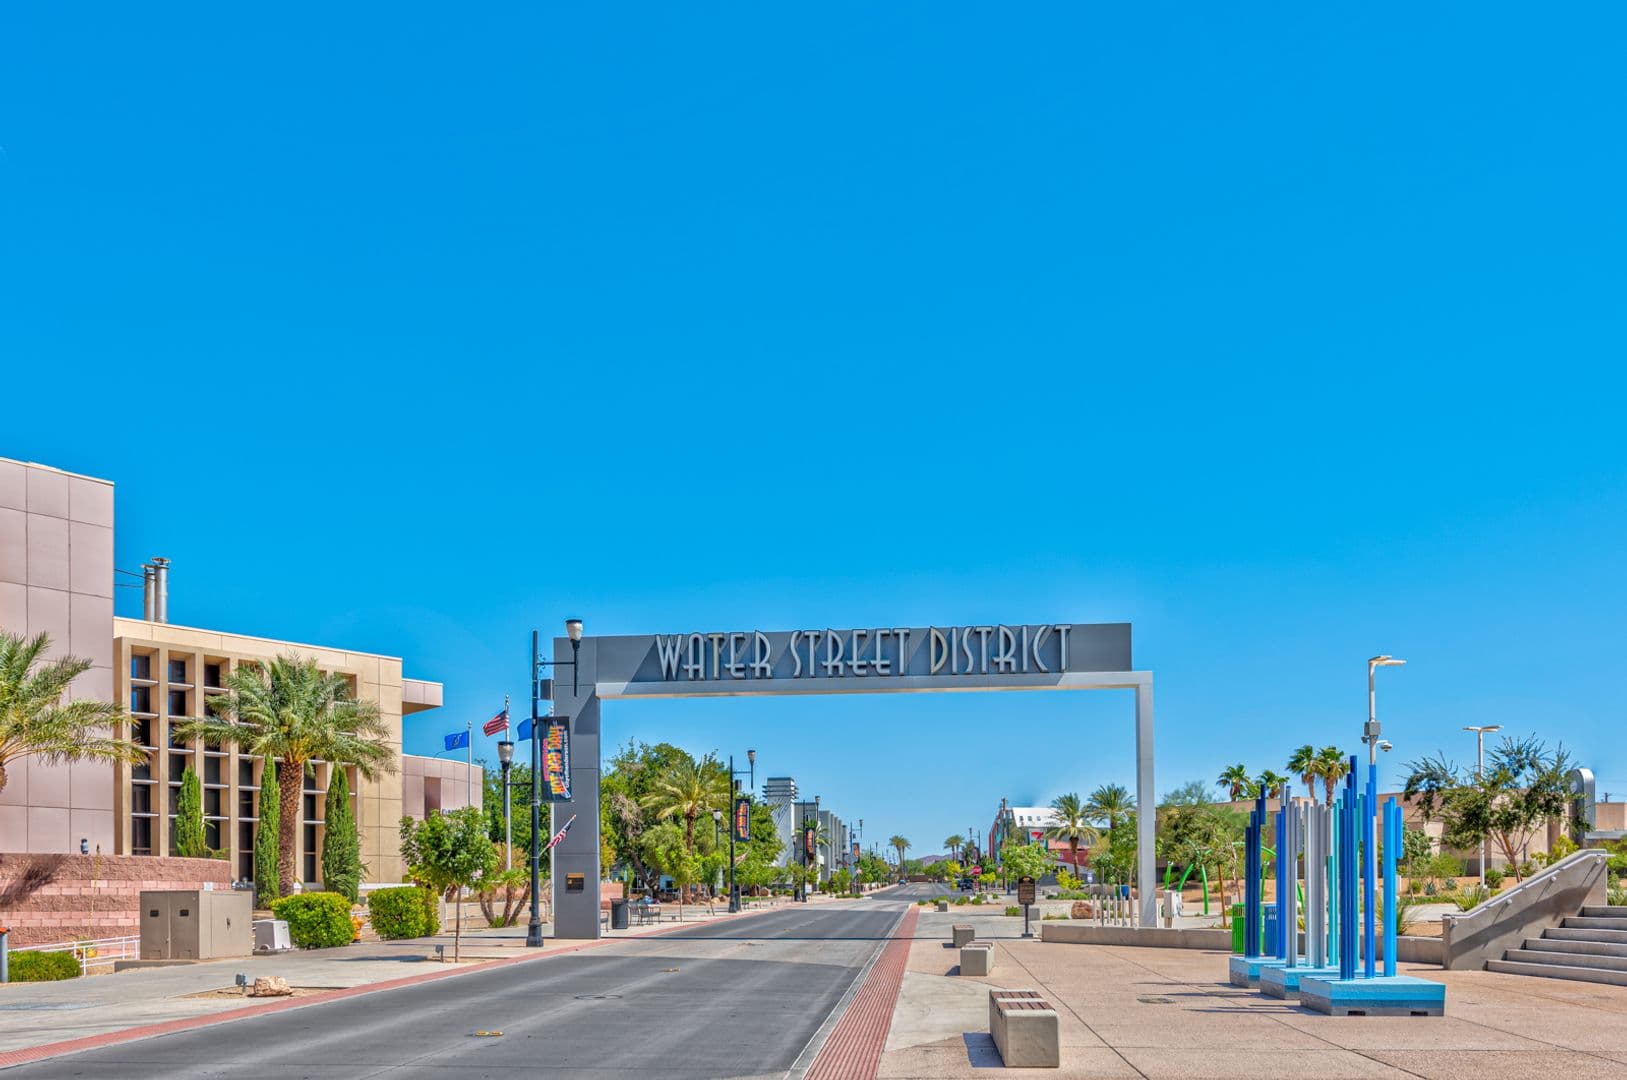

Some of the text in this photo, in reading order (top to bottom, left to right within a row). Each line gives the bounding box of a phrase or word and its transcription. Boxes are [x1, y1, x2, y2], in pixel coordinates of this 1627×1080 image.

[655, 624, 1071, 680] WATER STREET DISTRICT
